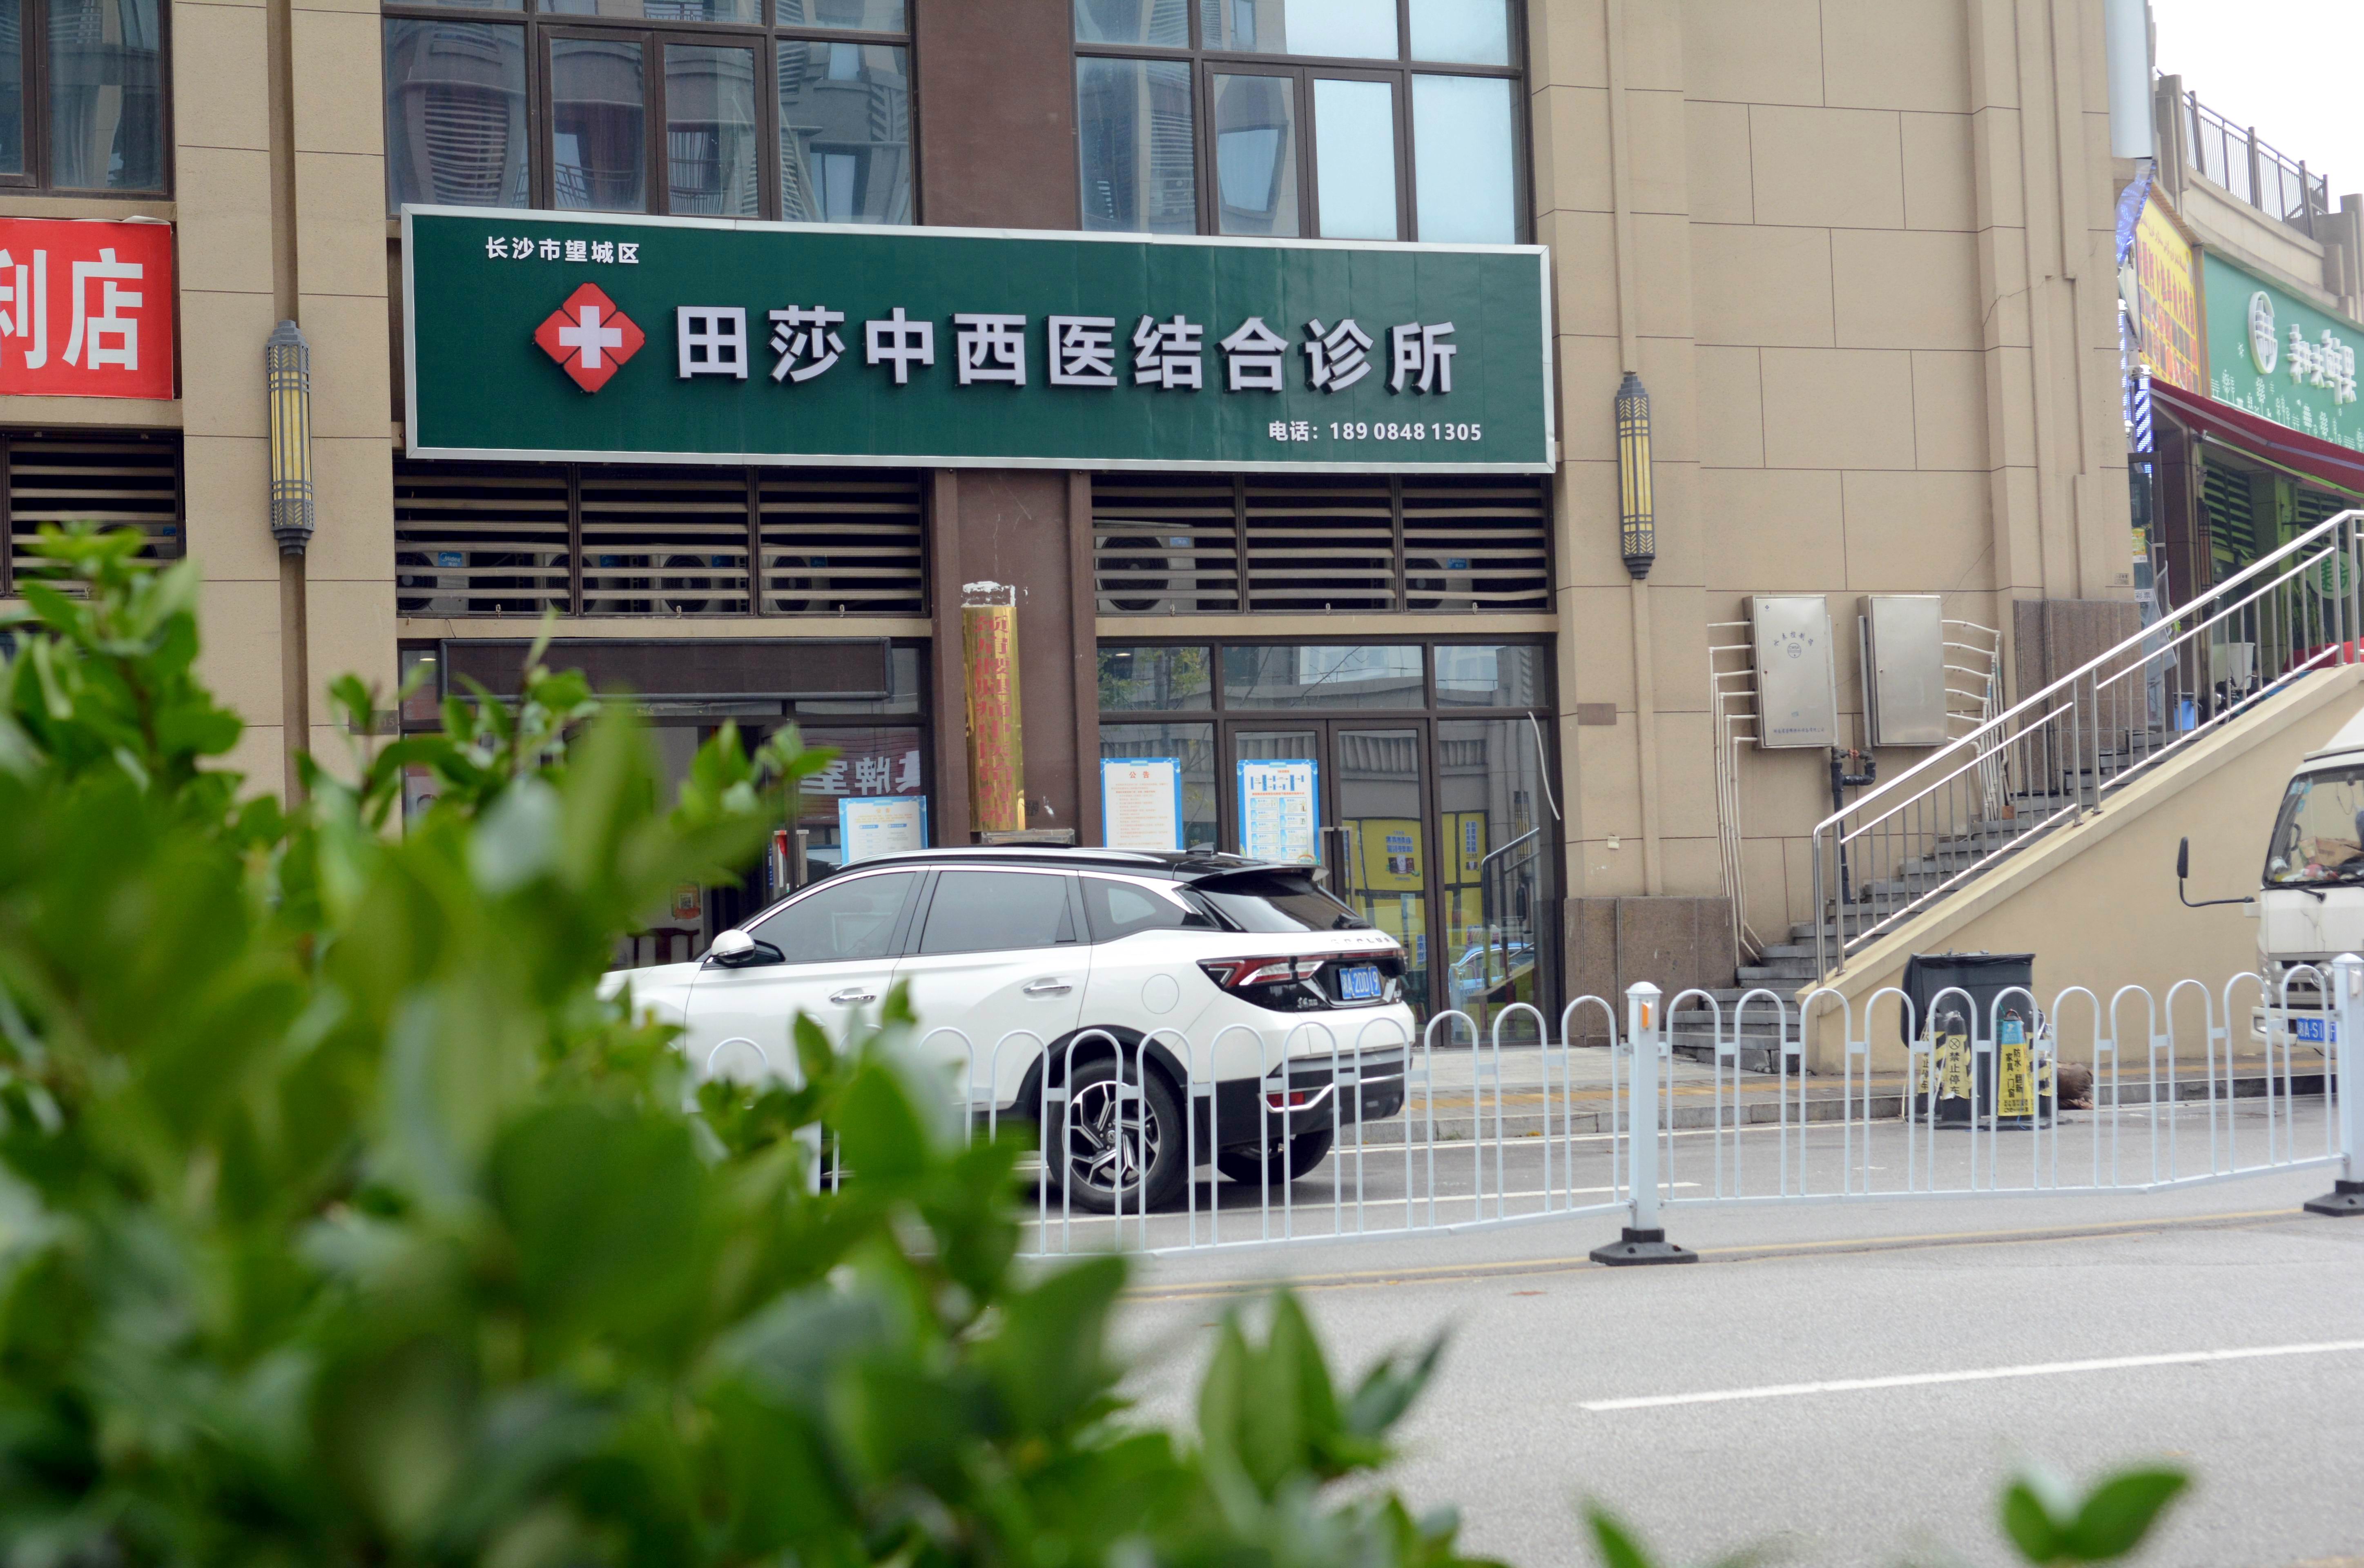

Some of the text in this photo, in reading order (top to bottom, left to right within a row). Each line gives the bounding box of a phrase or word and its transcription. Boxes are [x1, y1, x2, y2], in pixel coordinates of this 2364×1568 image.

[484, 236, 640, 265] 长沙市望城区
[674, 305, 1457, 394] 田莎中西医结合诊所
[1329, 422, 1368, 441] 189
[1373, 422, 1425, 441] 0848
[1431, 423, 1482, 442] 1305
[441, 553, 461, 562] Midea
[1129, 771, 1150, 779] 公告
